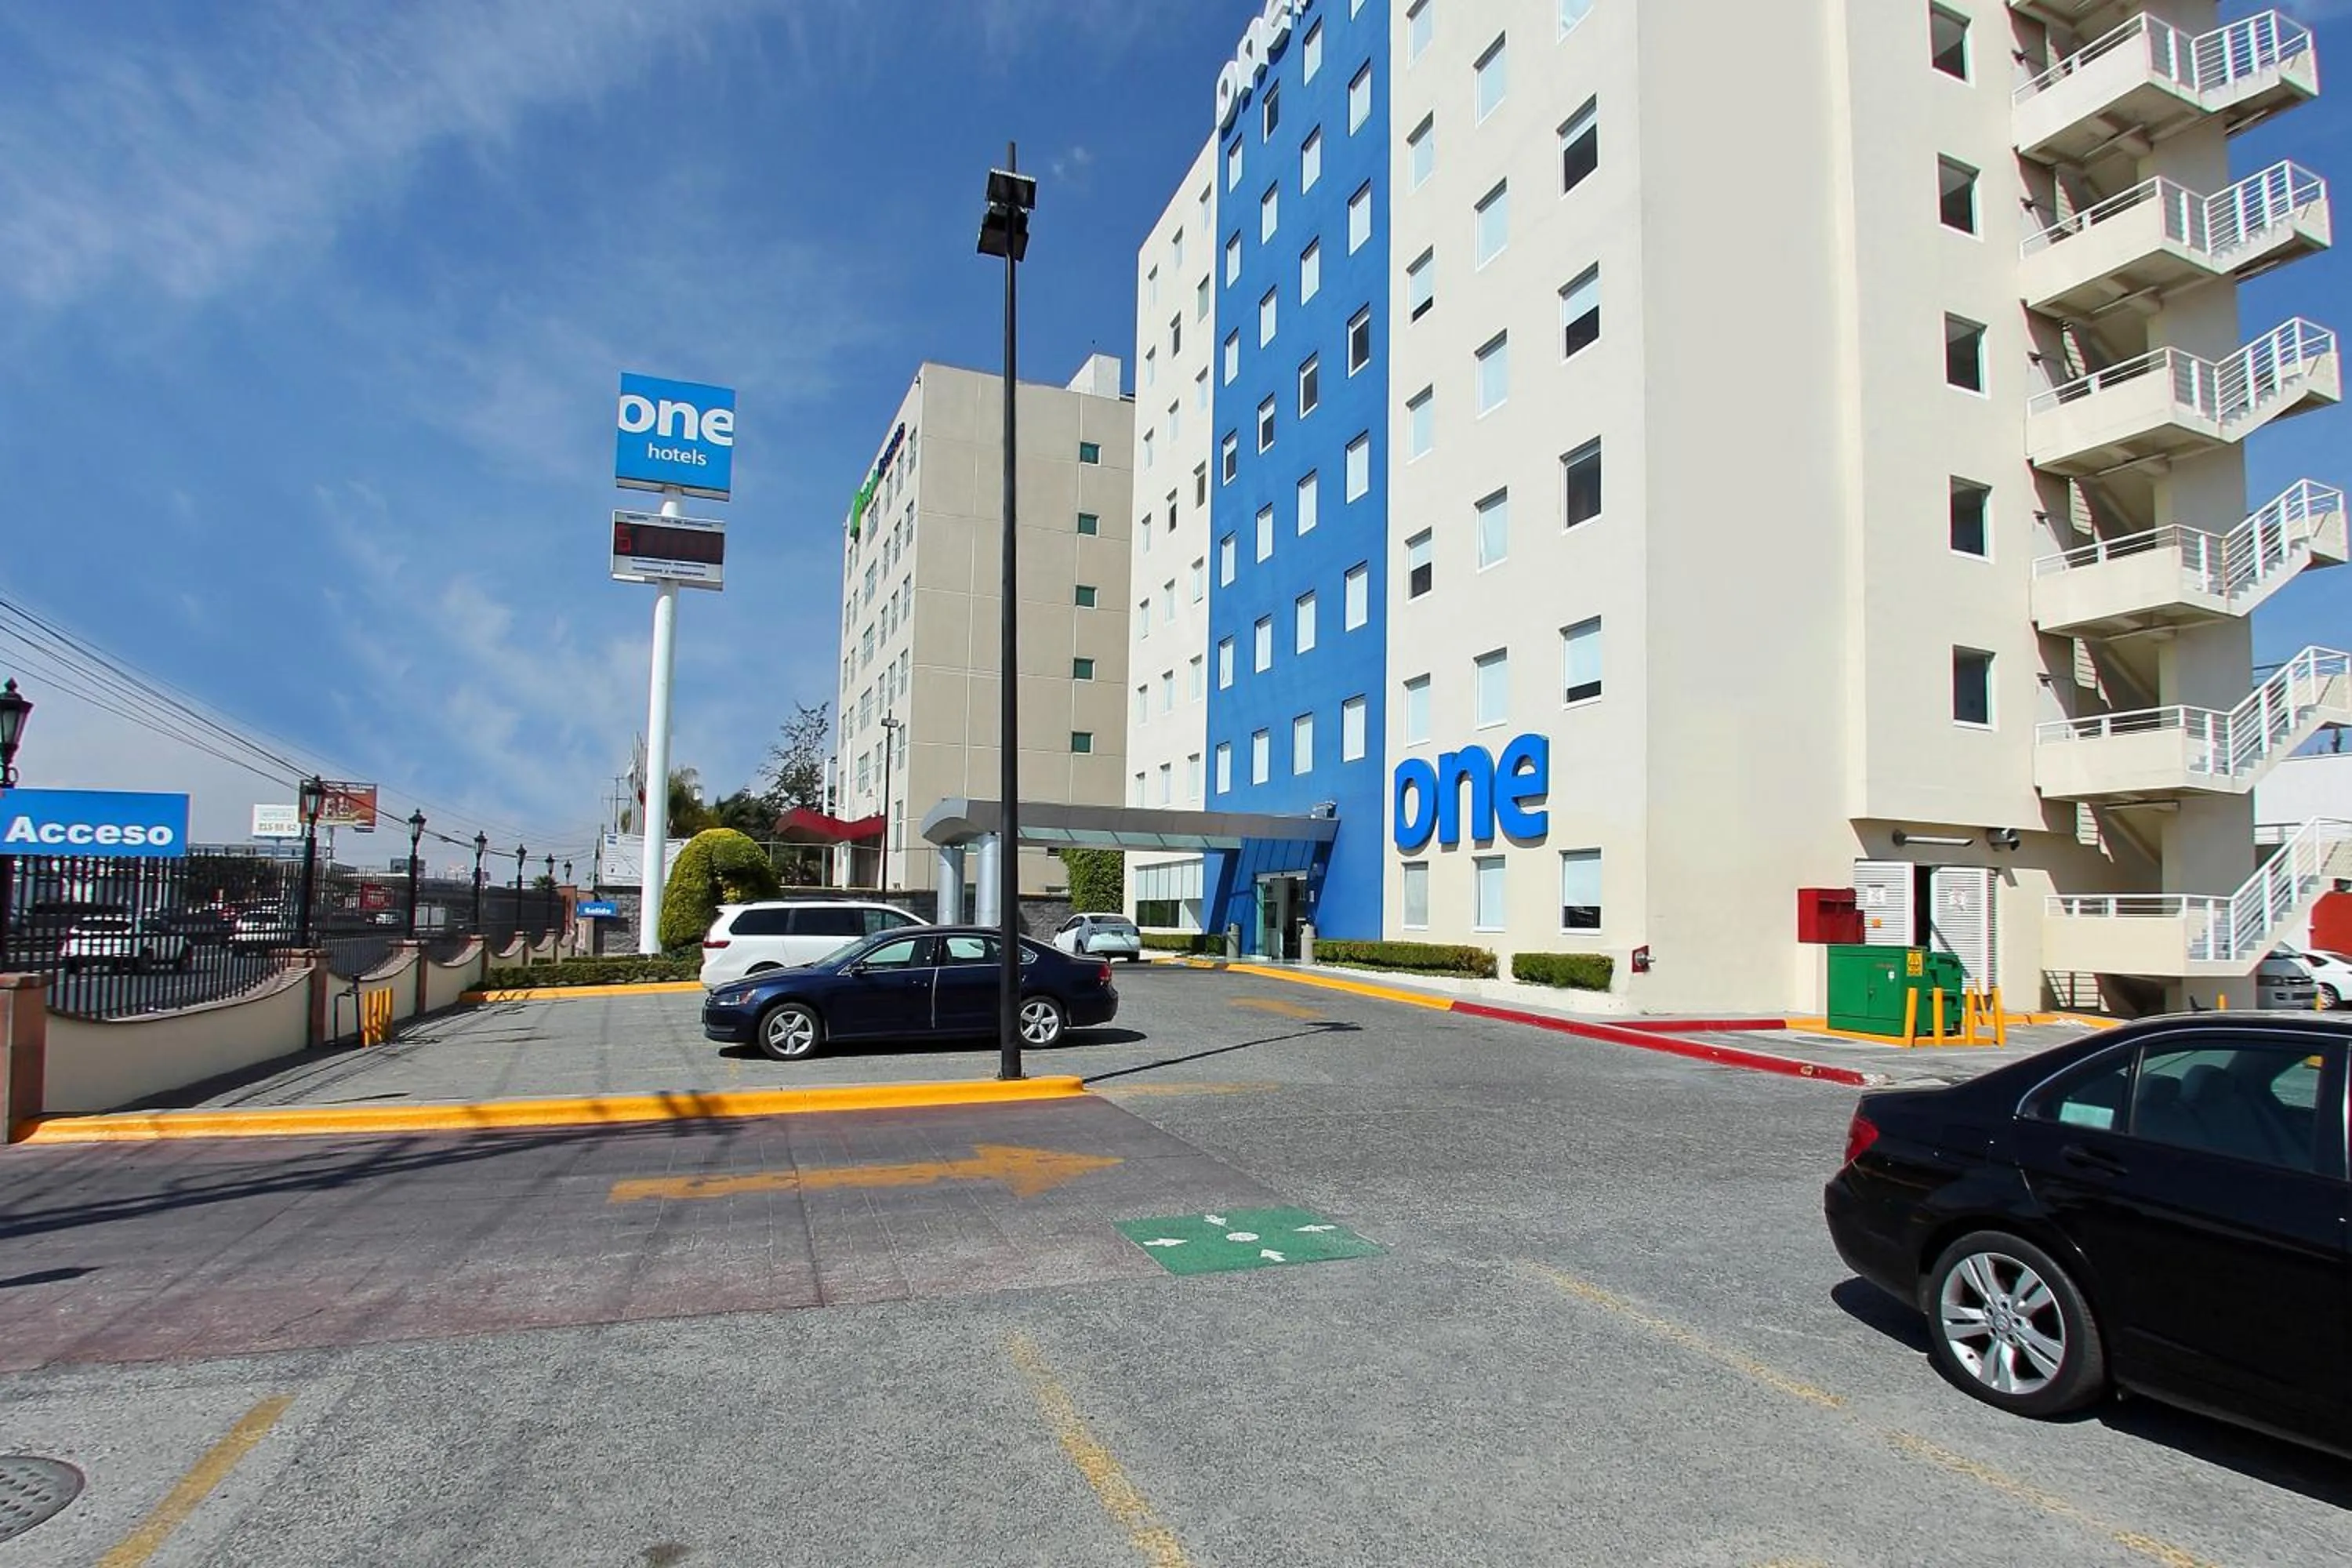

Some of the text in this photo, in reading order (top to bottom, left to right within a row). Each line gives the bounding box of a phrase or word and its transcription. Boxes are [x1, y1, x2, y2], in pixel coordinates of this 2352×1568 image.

[619, 394, 734, 446] one
[648, 442, 707, 466] hotels
[1394, 733, 1549, 850] one
[5, 815, 174, 846] Acceso
